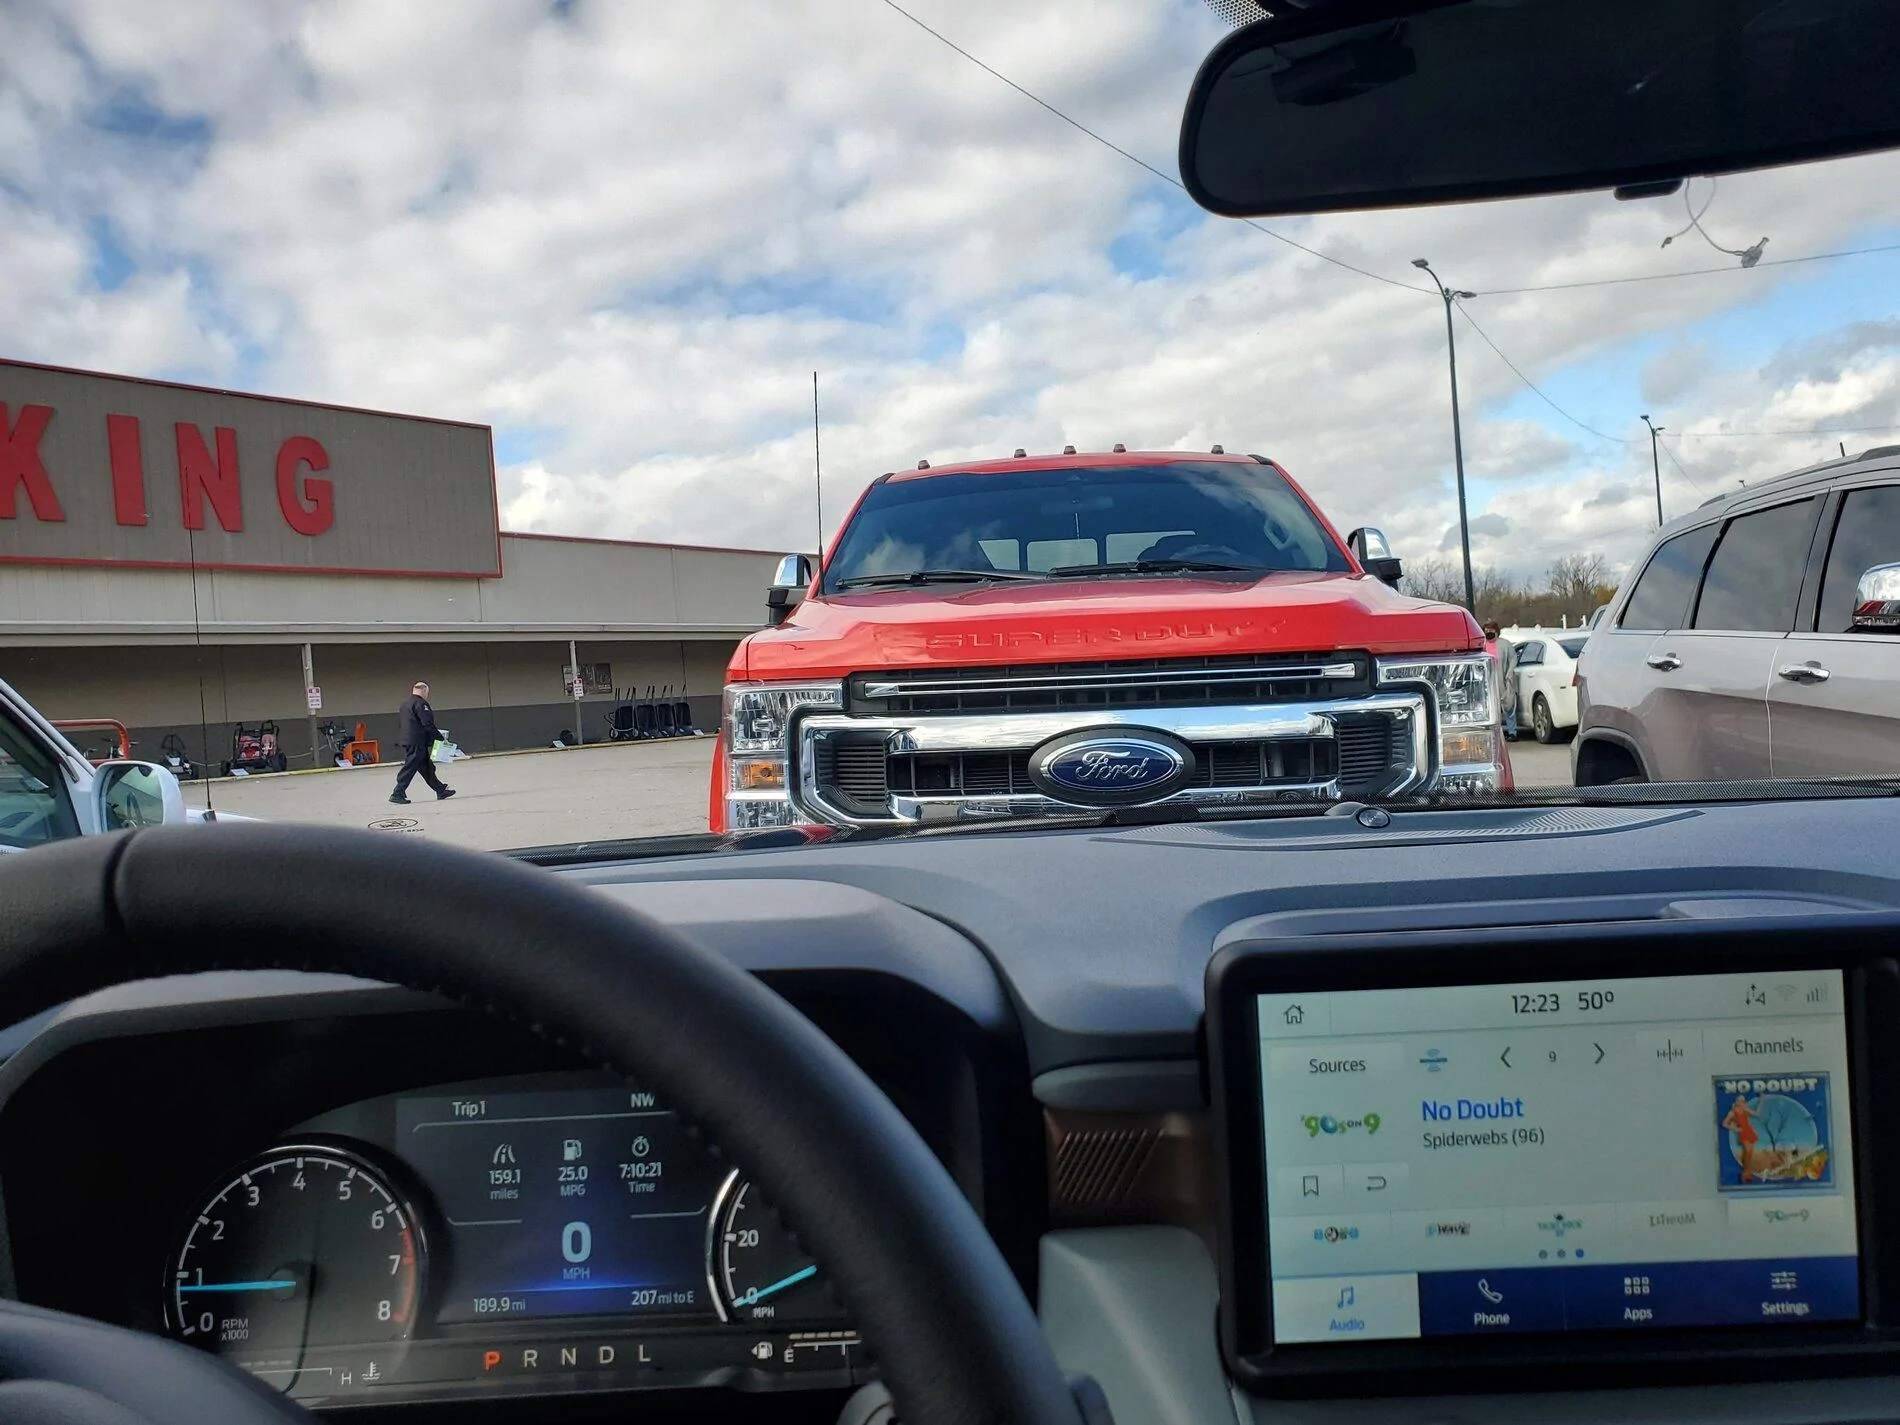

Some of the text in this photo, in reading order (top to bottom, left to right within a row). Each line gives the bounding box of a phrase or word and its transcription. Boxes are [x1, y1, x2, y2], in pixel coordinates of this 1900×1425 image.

[0, 404, 334, 536] KING
[1075, 750, 1149, 781] Ford
[1512, 993, 1561, 1014] 12:23
[1734, 1037, 1804, 1055] Channels
[1548, 1051, 1557, 1063] 9
[1309, 1058, 1366, 1074] Sources
[1753, 1078, 1818, 1093] DOUBT
[631, 1093, 655, 1108] NW
[1422, 1097, 1524, 1121] No Doubt
[1423, 1127, 1545, 1149] Spiderwebs (96)
[489, 1169, 521, 1185] 159.1
[558, 1166, 588, 1182] 25.0
[619, 1162, 662, 1179] 7:10:21
[293, 1172, 306, 1191] 4
[628, 1181, 656, 1194] Time
[248, 1186, 260, 1207] 3
[339, 1181, 351, 1201] 5
[490, 1188, 519, 1200] miles
[560, 1185, 586, 1197] MPG
[371, 1210, 384, 1229] 6
[213, 1221, 225, 1241] 2
[738, 1229, 759, 1247] 20
[562, 1221, 592, 1263] 0
[389, 1255, 401, 1275] 7
[563, 1267, 590, 1281] MPH
[474, 1297, 525, 1313] 189.9 mi
[631, 1290, 658, 1306] 207
[377, 1300, 391, 1321] 8
[752, 1306, 775, 1318] MPH
[1624, 1307, 1653, 1322] Apps
[1762, 1301, 1810, 1317] Settings
[200, 1312, 213, 1332] 0
[222, 1318, 249, 1330] RPM
[1329, 1318, 1366, 1332] Audio
[1474, 1312, 1510, 1326] Phone
[484, 1344, 651, 1370] P R N D L
[783, 1348, 794, 1363] E
[341, 1372, 352, 1385] H
